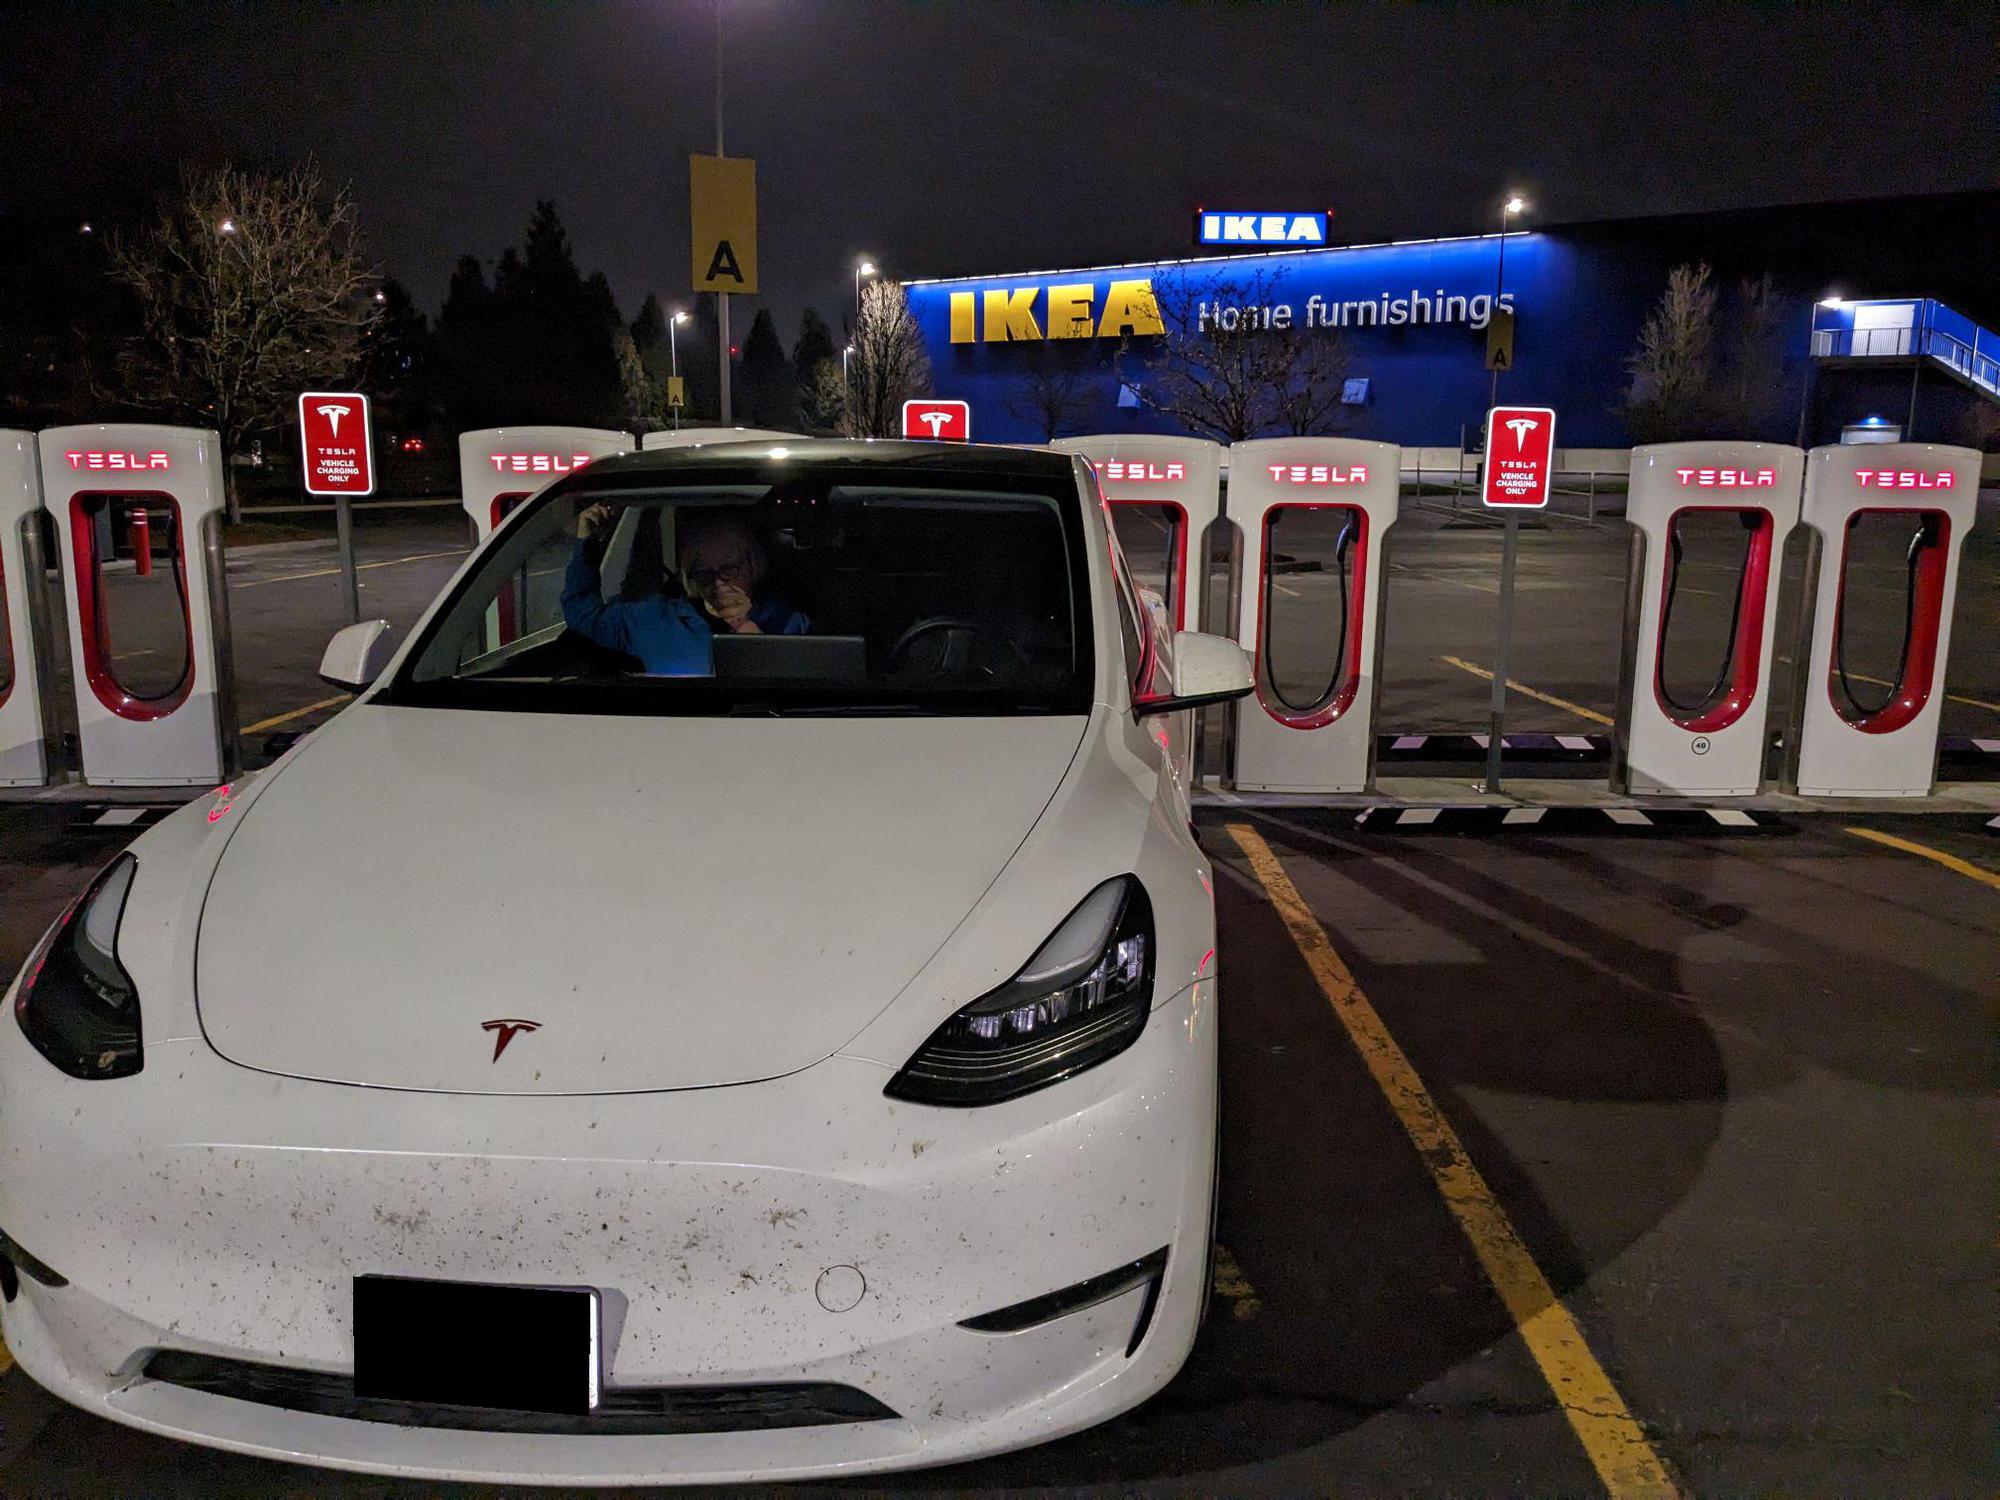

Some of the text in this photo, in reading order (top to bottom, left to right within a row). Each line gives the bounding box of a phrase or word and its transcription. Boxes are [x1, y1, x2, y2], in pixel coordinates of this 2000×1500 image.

[1203, 215, 1323, 241] IKEA
[706, 239, 744, 283] A
[949, 279, 1166, 343] IKEA
[1198, 289, 1514, 332] Home furnishings
[1493, 348, 1507, 366] A
[672, 394, 681, 403] A
[66, 452, 169, 469] TESLA
[320, 459, 355, 468] VEHICLE
[316, 467, 360, 475] CHARGING
[1094, 463, 1184, 479] ESLA
[1268, 465, 1367, 483] TESLA
[1501, 472, 1534, 480] VEHICLE
[1676, 469, 1775, 486] TESLA
[1855, 471, 1952, 487] TESLA
